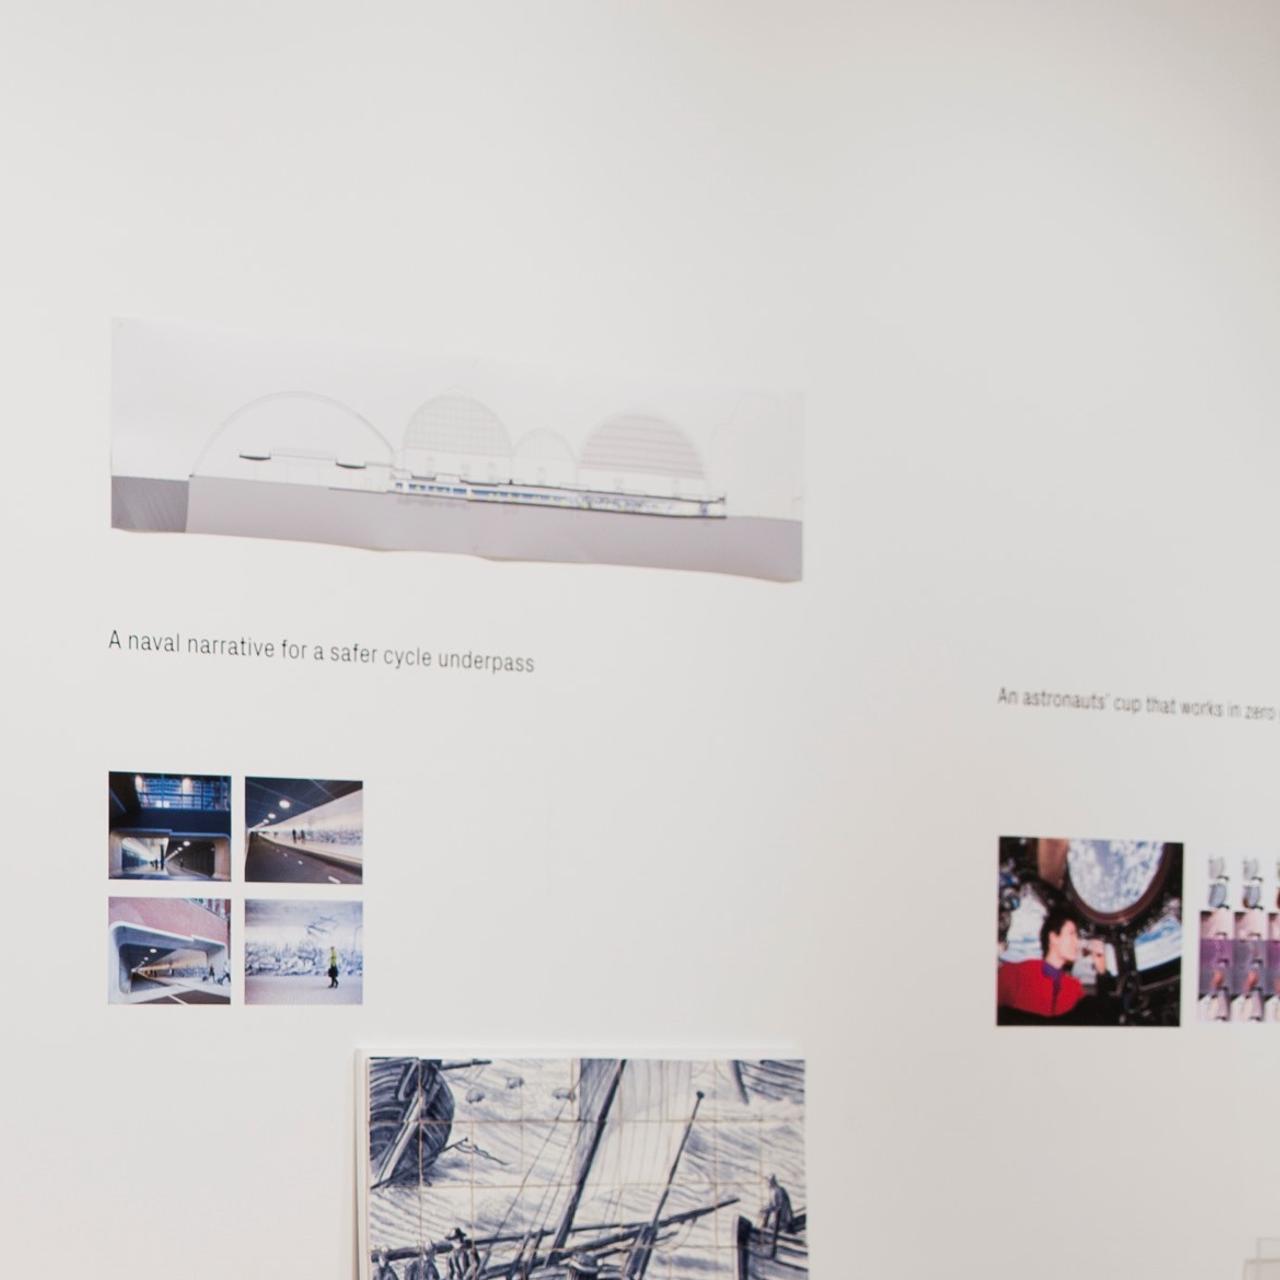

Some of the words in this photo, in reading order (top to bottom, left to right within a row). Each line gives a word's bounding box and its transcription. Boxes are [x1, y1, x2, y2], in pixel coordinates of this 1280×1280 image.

[109, 630, 122, 649] A
[128, 633, 181, 652] naval
[187, 636, 275, 658] narrative
[281, 639, 308, 660] for
[313, 645, 324, 661] a
[330, 643, 378, 663] safer
[383, 647, 432, 670] cycle
[438, 650, 535, 675] underpass
[997, 687, 1018, 705] An
[1113, 696, 1142, 714] cup
[1146, 695, 1176, 715] that
[1180, 699, 1224, 718] works
[1227, 701, 1241, 718] in
[1244, 704, 1276, 721] zero
